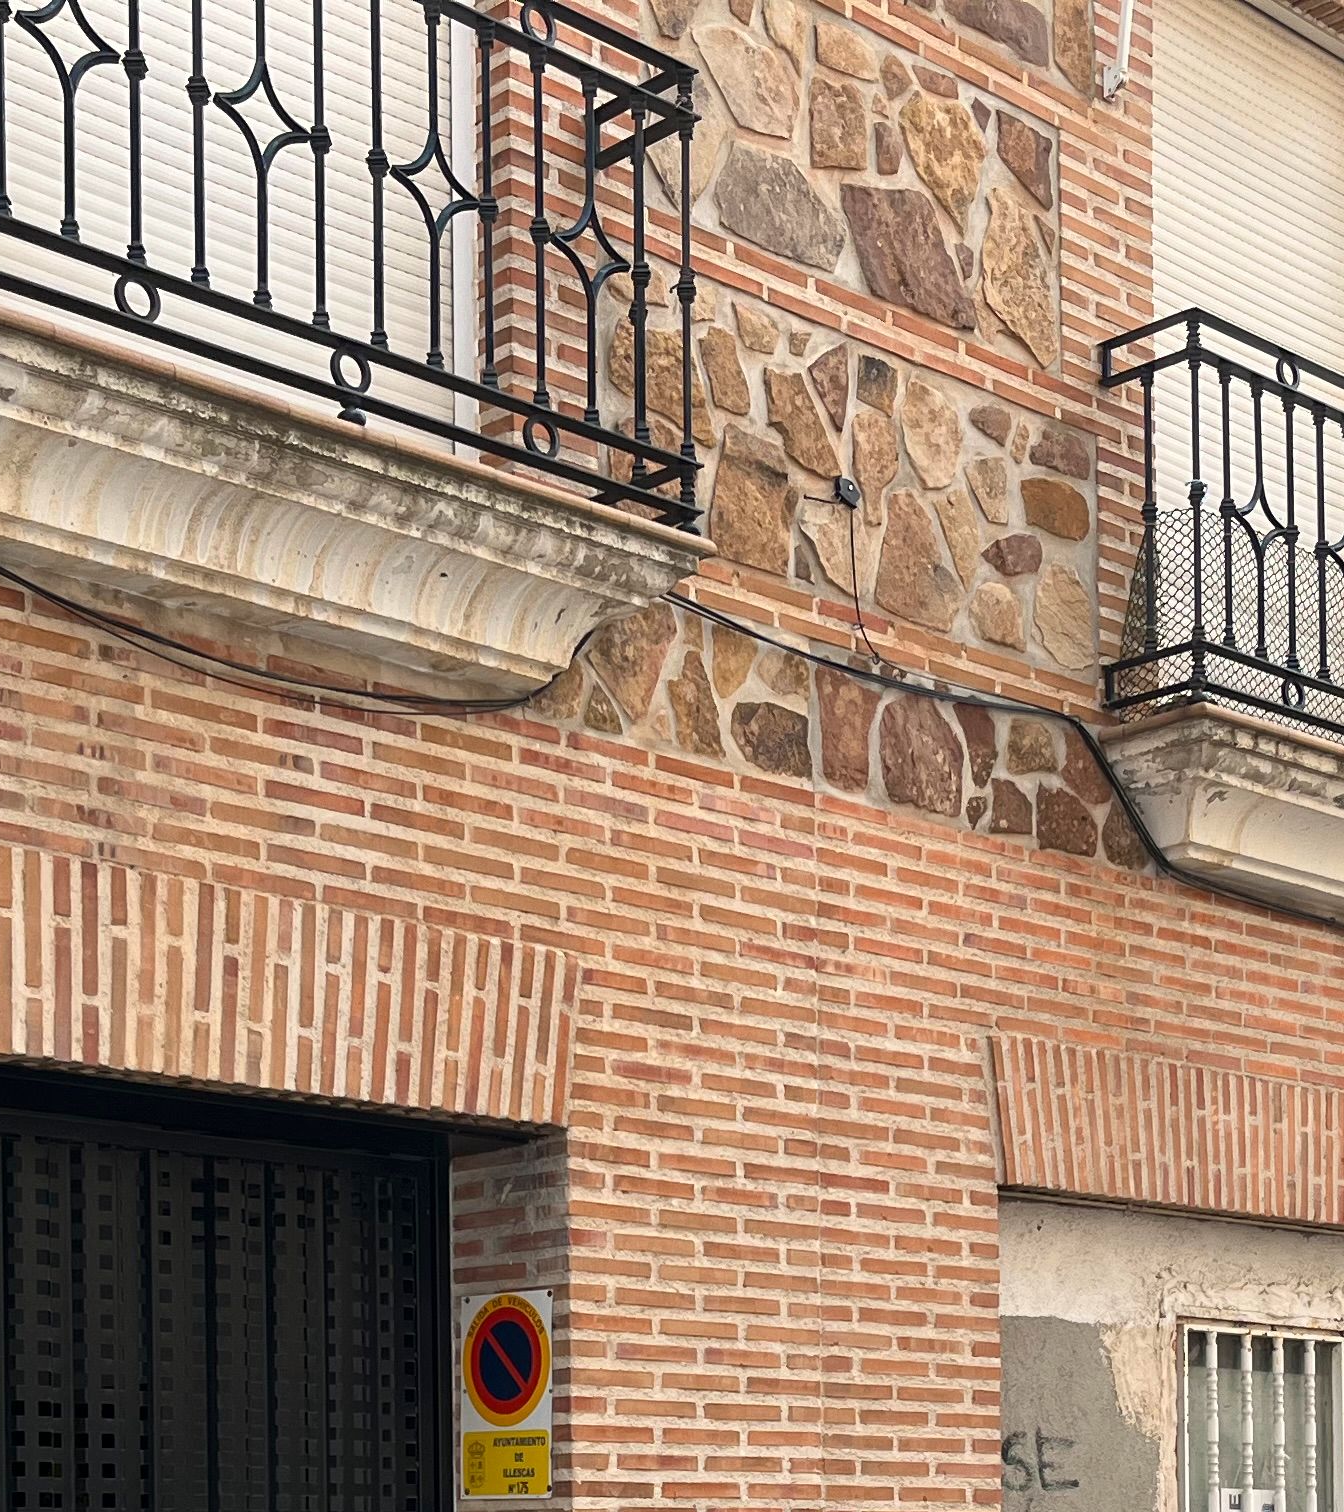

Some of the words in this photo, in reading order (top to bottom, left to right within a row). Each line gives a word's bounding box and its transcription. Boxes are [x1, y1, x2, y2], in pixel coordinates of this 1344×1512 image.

[467, 1306, 490, 1338] SALIDA
[492, 1297, 503, 1308] DE
[492, 1436, 546, 1448] AYUNTAMIENTO
[514, 1452, 524, 1463] DE
[1001, 1426, 1080, 1491] SE
[502, 1467, 536, 1478] ILLESCAS
